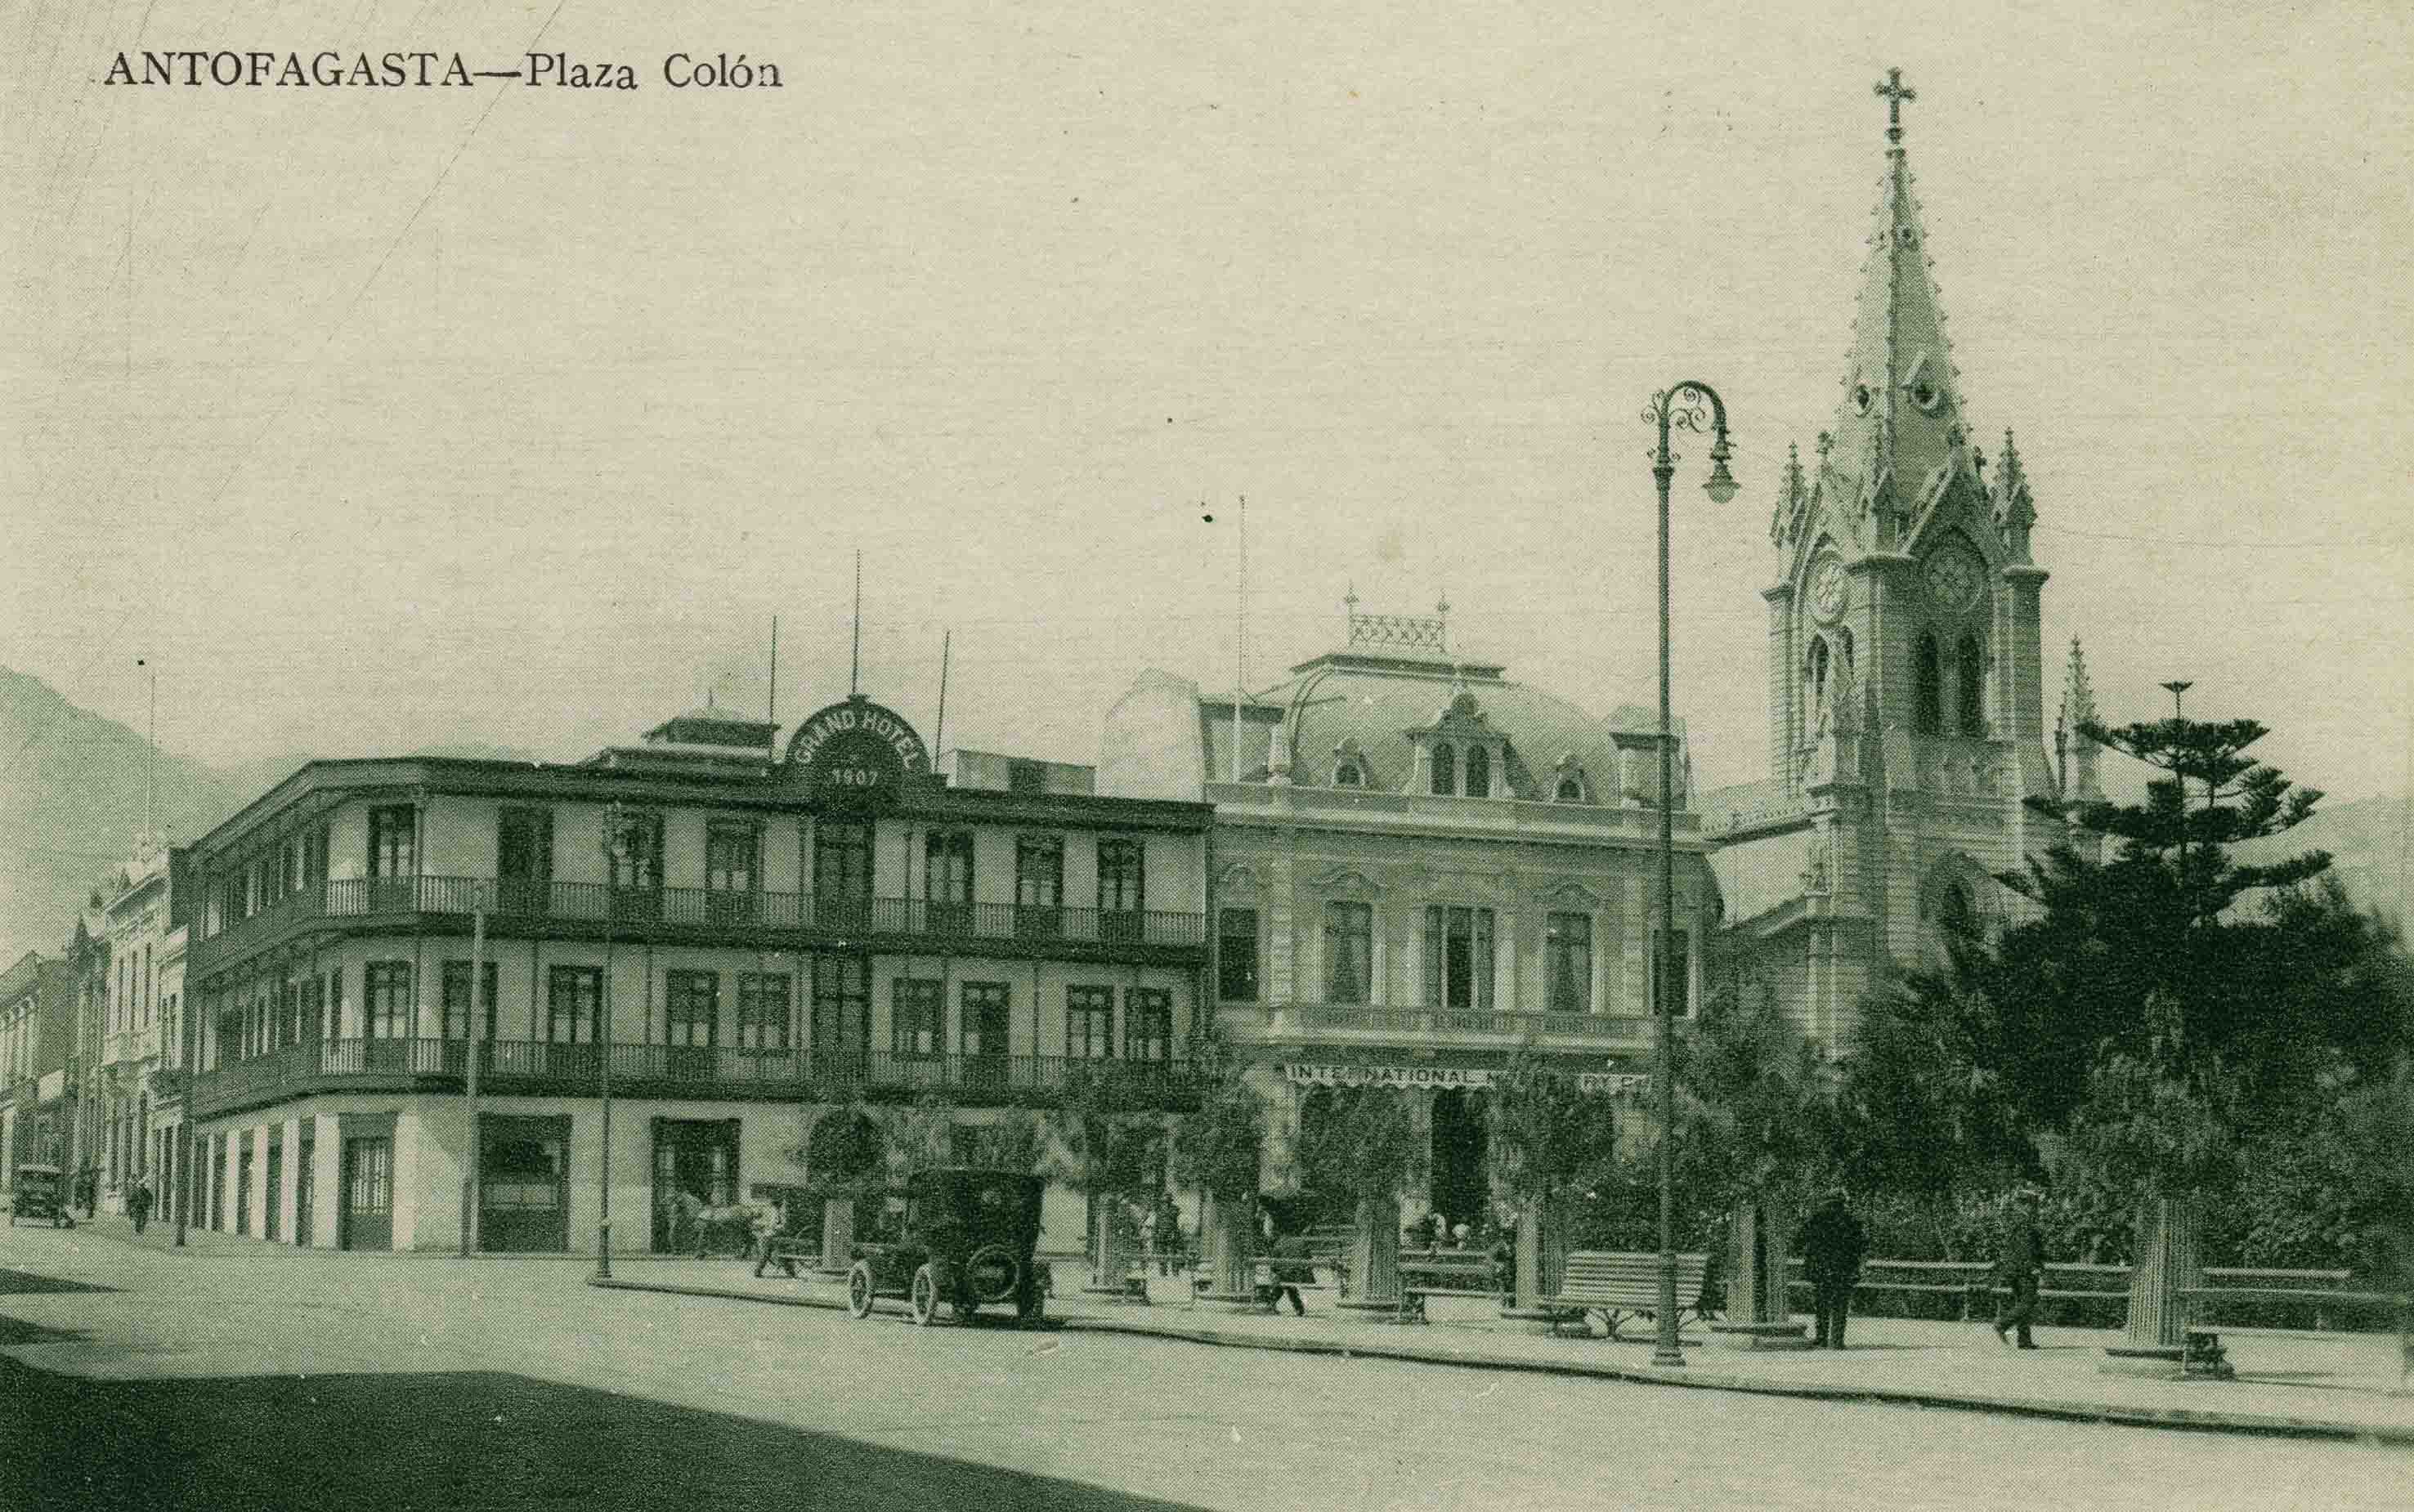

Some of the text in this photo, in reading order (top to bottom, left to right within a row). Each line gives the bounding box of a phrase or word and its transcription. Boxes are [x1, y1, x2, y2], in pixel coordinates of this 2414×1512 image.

[794, 709, 920, 770] GRAND HOTEL
[831, 768, 880, 786] 1907
